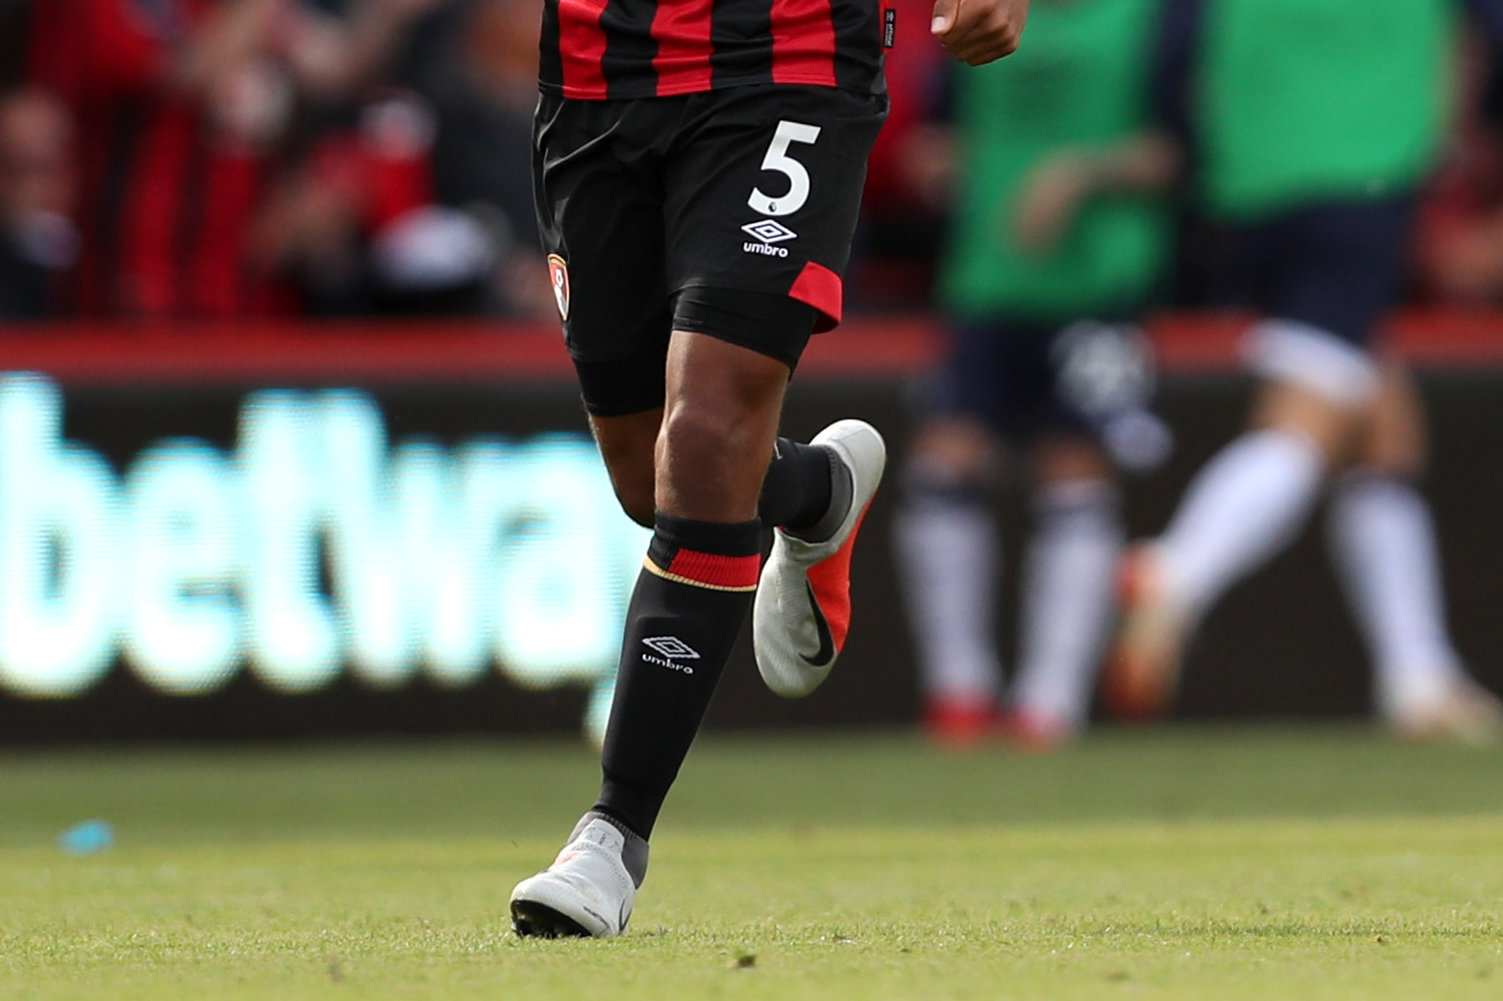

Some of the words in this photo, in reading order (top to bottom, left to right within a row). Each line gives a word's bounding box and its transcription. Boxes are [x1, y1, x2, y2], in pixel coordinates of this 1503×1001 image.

[747, 120, 822, 216] 5
[742, 241, 789, 258] umbro
[641, 653, 694, 675] umbro
